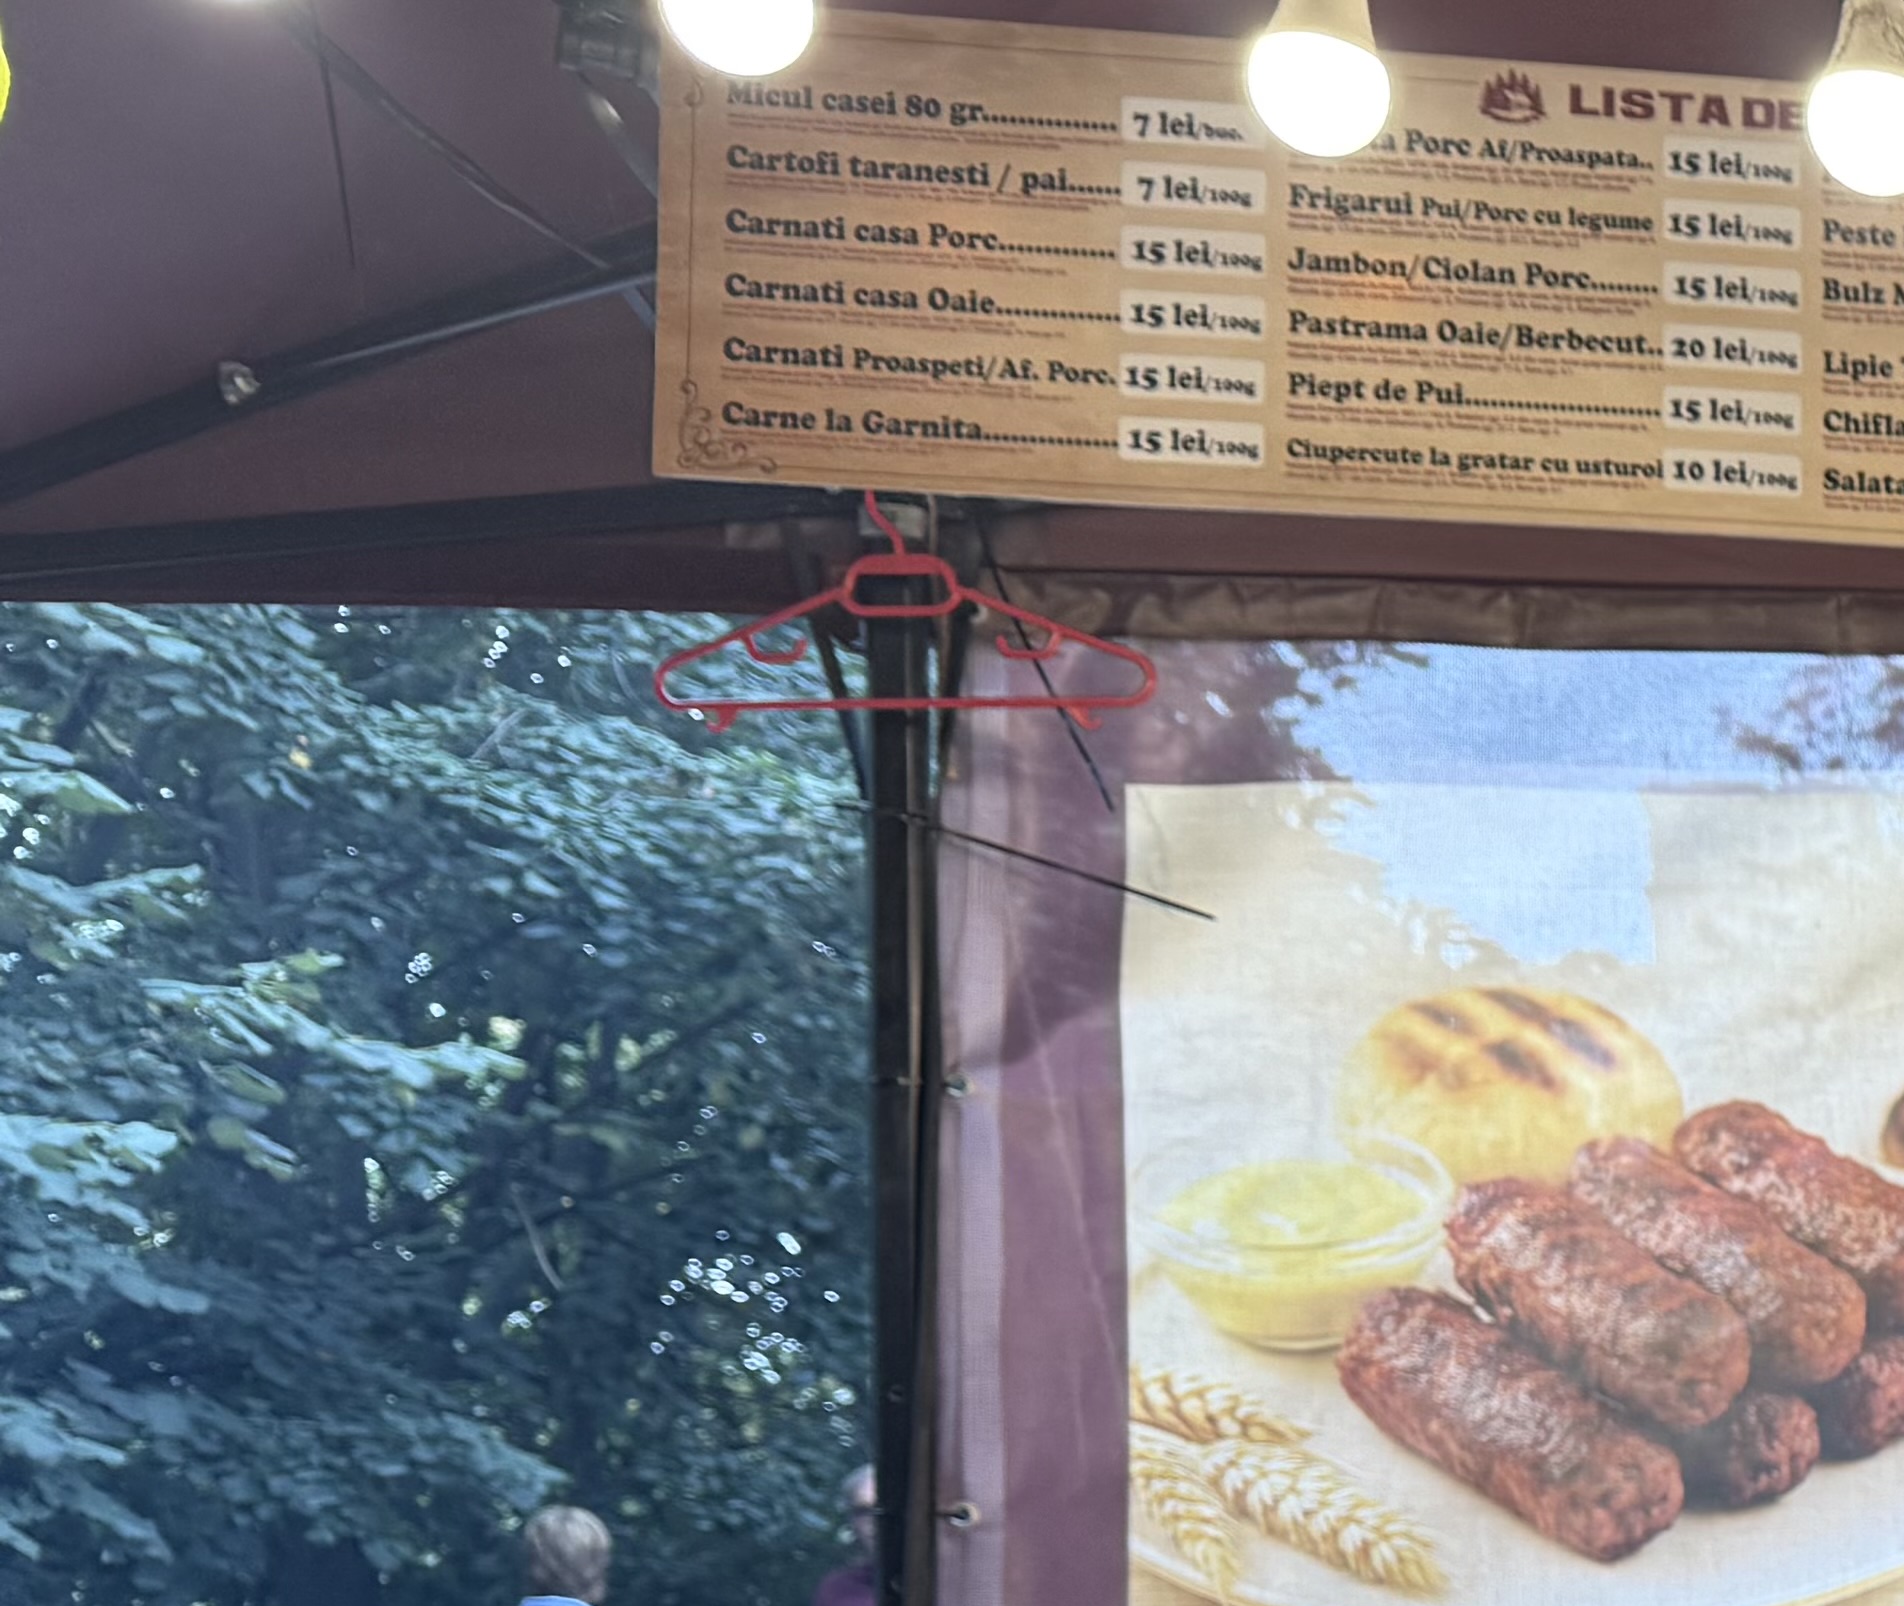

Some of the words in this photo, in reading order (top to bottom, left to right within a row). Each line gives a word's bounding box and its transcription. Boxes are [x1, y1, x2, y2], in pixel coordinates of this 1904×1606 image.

[822, 92, 896, 116] casei
[906, 97, 940, 118] 80
[1134, 114, 1150, 137] 7
[1569, 84, 1731, 126] LISTA
[1741, 99, 1806, 129] DE
[727, 145, 840, 178] Cartofi
[849, 156, 990, 187] taranesti
[1137, 179, 1154, 200] 7
[1406, 129, 1472, 157] Porc
[1669, 152, 1700, 174] 15
[1288, 184, 1413, 217] Frigarui
[1422, 197, 1528, 227] Pui/Porc
[1534, 205, 1561, 225] cu
[1569, 205, 1653, 234] legume
[1669, 215, 1700, 236] 15
[1823, 219, 1896, 247] Peste
[726, 210, 845, 240] Carnati
[854, 223, 918, 245] casa
[1133, 241, 1165, 263] 15
[1287, 248, 1516, 287] Jambon/Ciolan
[1674, 277, 1705, 297] 15
[1823, 279, 1884, 307] Bulz
[724, 274, 845, 305] Carnati
[852, 287, 918, 310] casa
[1131, 304, 1163, 326] 15
[1287, 311, 1428, 341] Pastrama
[1671, 340, 1704, 358] 20
[724, 338, 843, 368] Carnati
[1125, 367, 1158, 389] 15
[1823, 351, 1893, 382] Lipie
[1287, 372, 1366, 402] Piept
[1373, 379, 1407, 402] de
[1669, 401, 1700, 420] 15
[723, 402, 815, 430] Carne
[824, 407, 852, 433] la
[1127, 431, 1161, 452] 15
[1287, 439, 1423, 467] Ciupercute
[1430, 446, 1452, 466] la
[1458, 449, 1534, 473] gratar
[1542, 458, 1569, 475] cu
[1576, 456, 1663, 480] usturoi
[1672, 463, 1703, 480] 10
